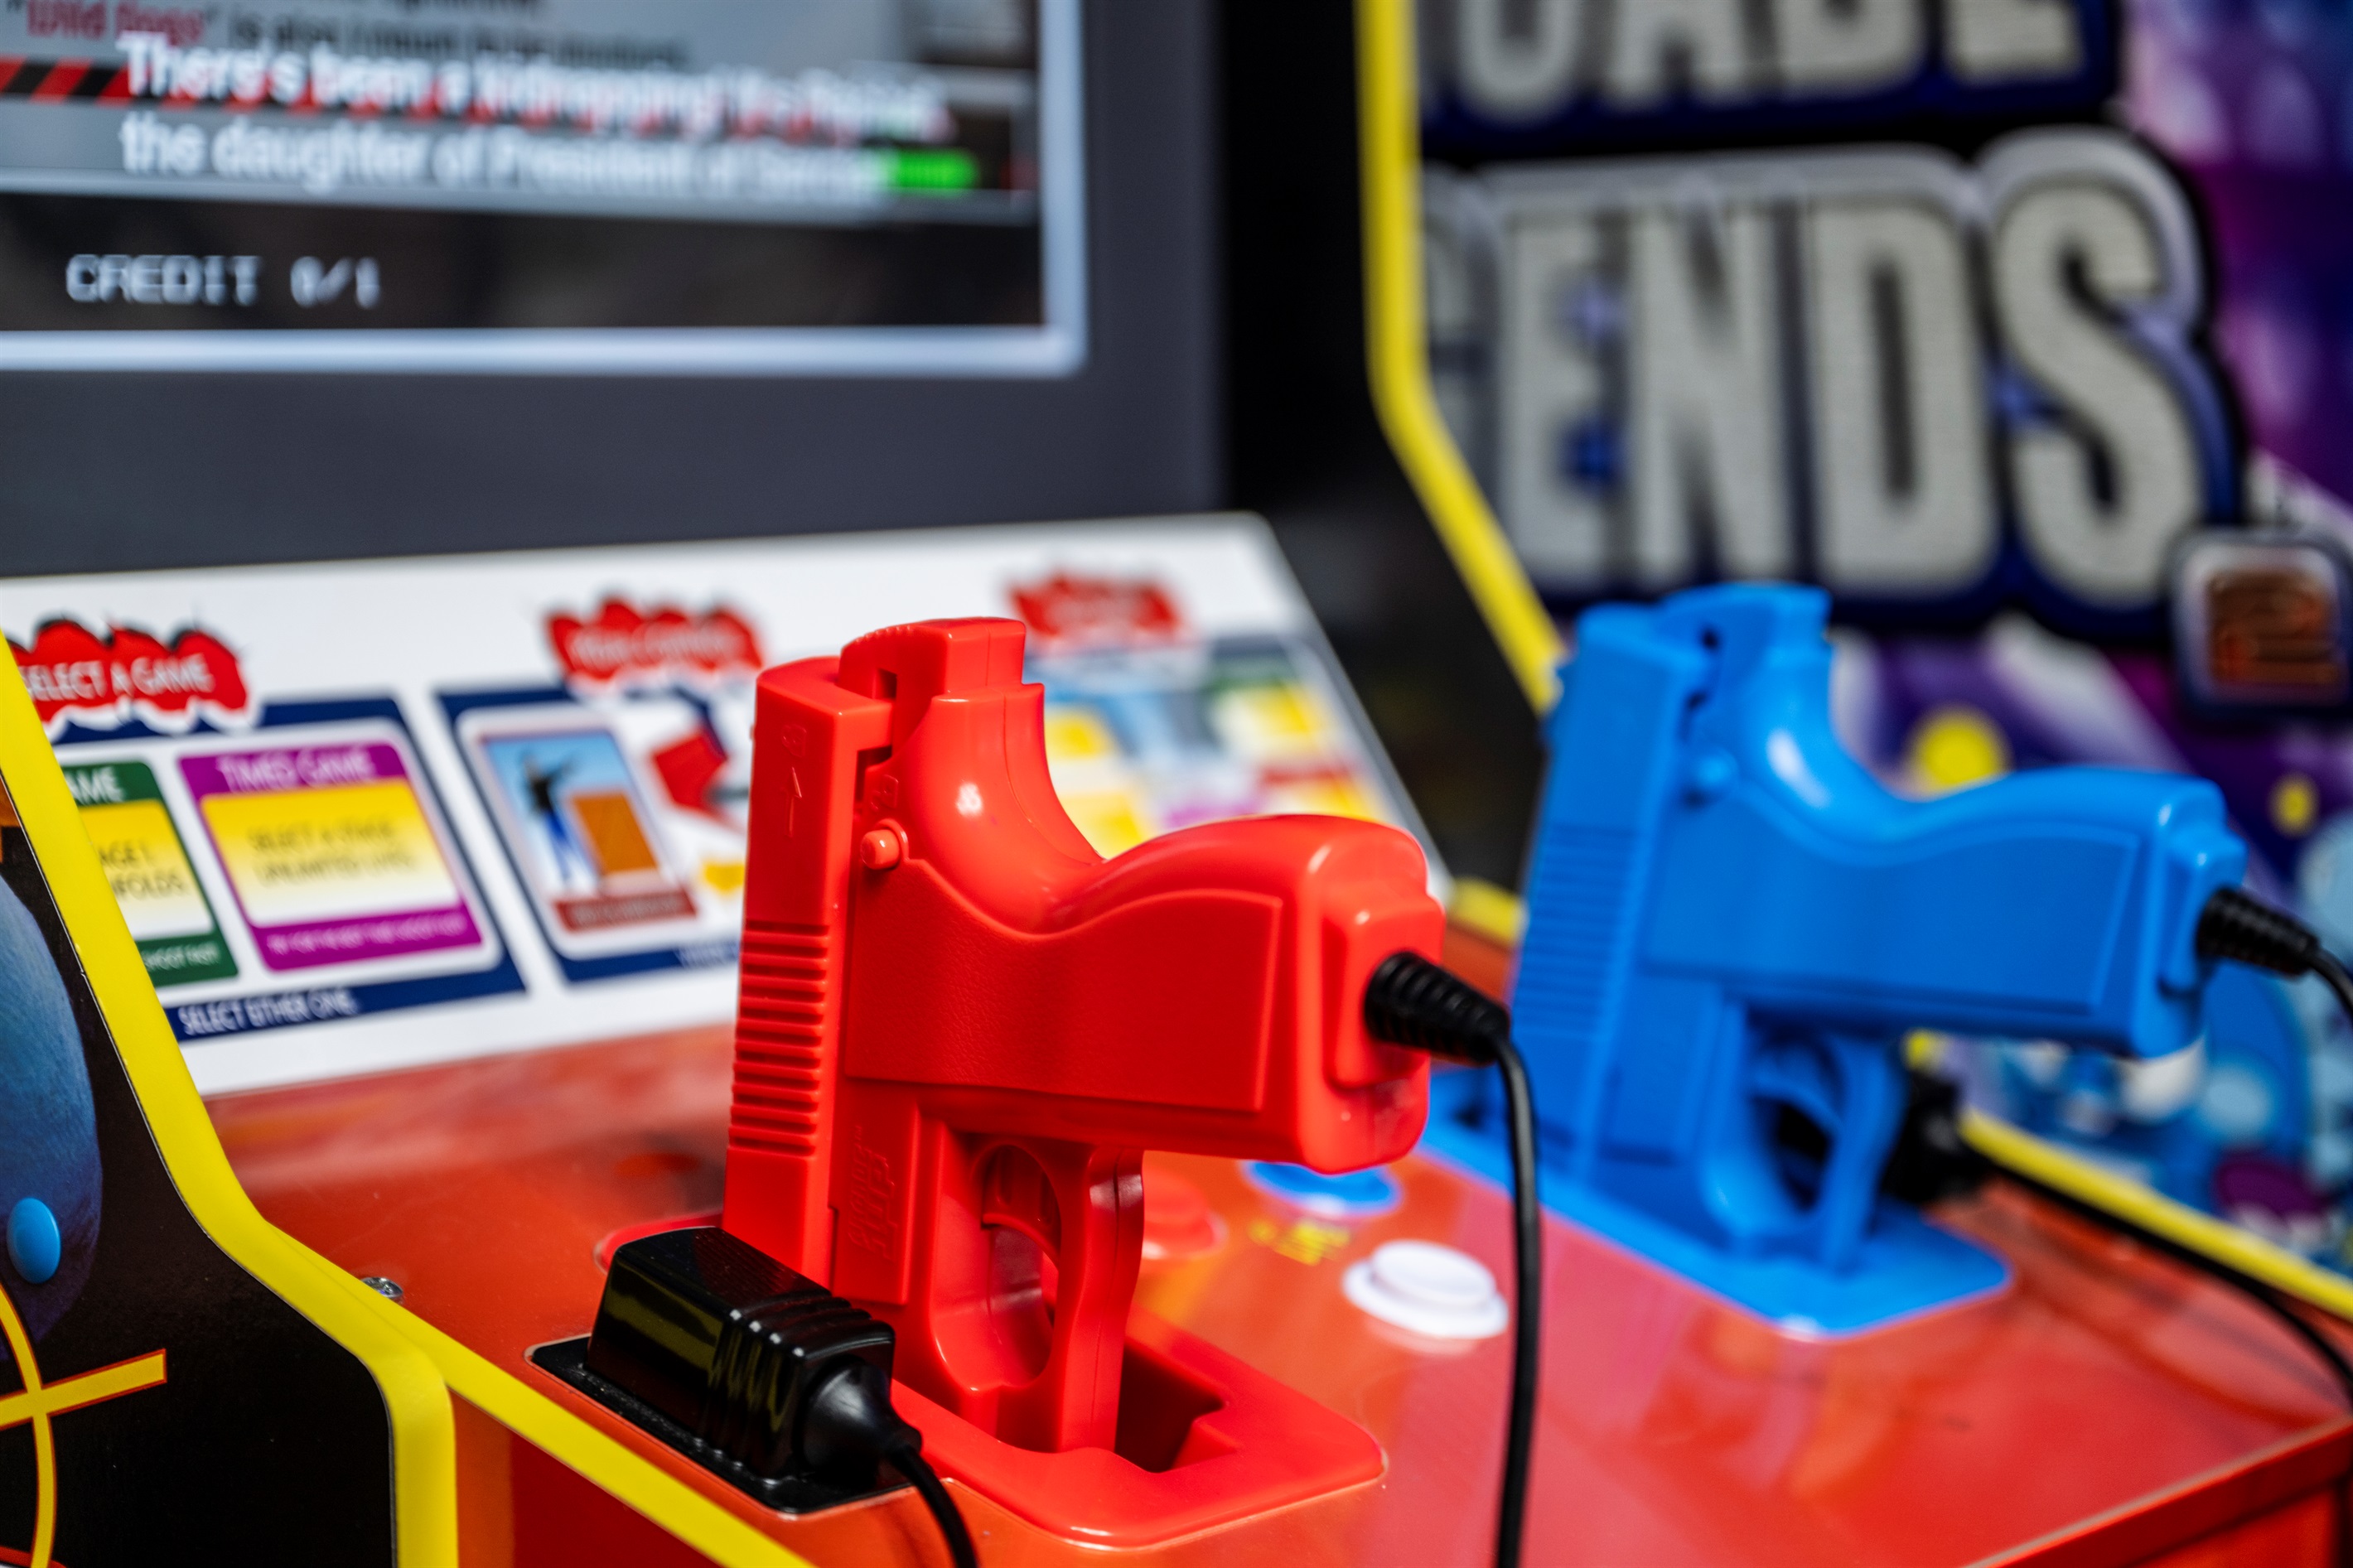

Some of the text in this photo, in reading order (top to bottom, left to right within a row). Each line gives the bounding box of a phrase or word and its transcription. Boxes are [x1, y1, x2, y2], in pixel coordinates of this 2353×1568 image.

[114, 30, 308, 105] There's
[118, 109, 209, 177] the
[211, 114, 428, 195] daughter
[66, 253, 260, 305] CREDIT
[109, 661, 136, 697] A
[64, 765, 126, 805] AME
[215, 740, 379, 794] TIMED GAME
[176, 999, 247, 1037] SELECT
[245, 991, 312, 1029] EITHER
